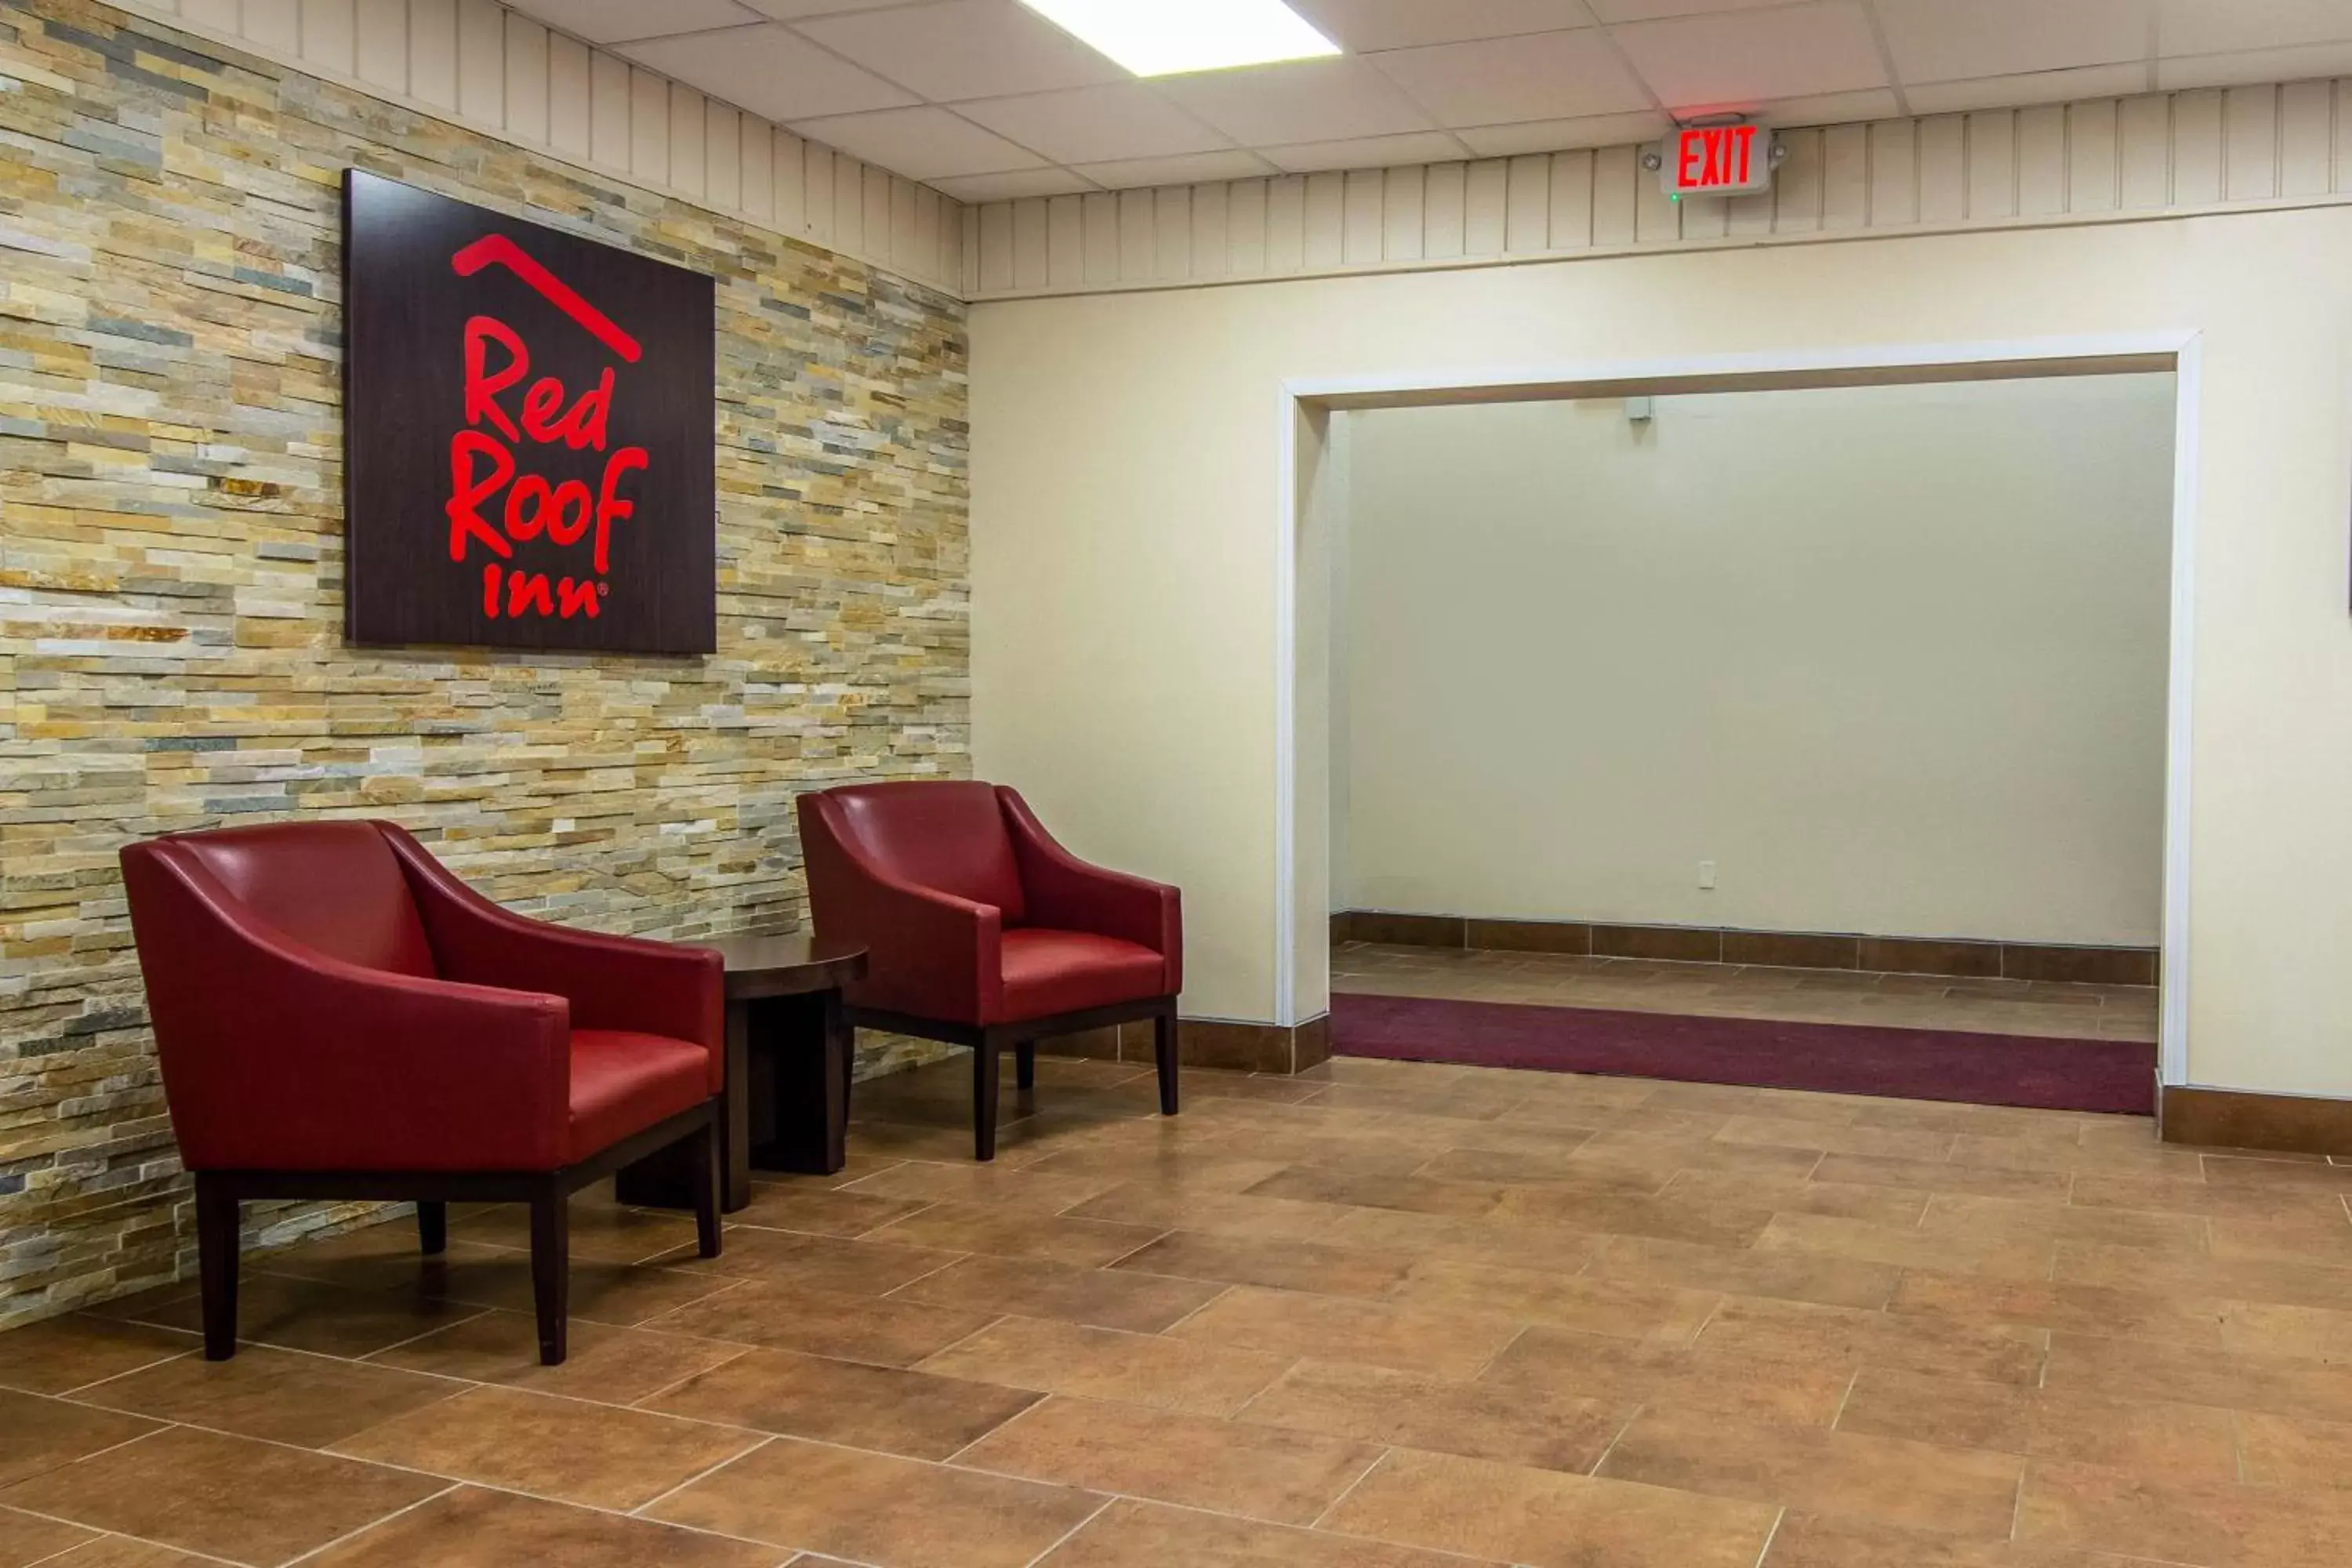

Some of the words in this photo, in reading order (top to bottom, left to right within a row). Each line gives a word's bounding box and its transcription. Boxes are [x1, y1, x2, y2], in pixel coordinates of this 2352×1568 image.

[1679, 126, 1756, 187] EXIT
[464, 316, 615, 452] Red
[445, 430, 648, 574] Roof
[484, 564, 600, 619] Inn
